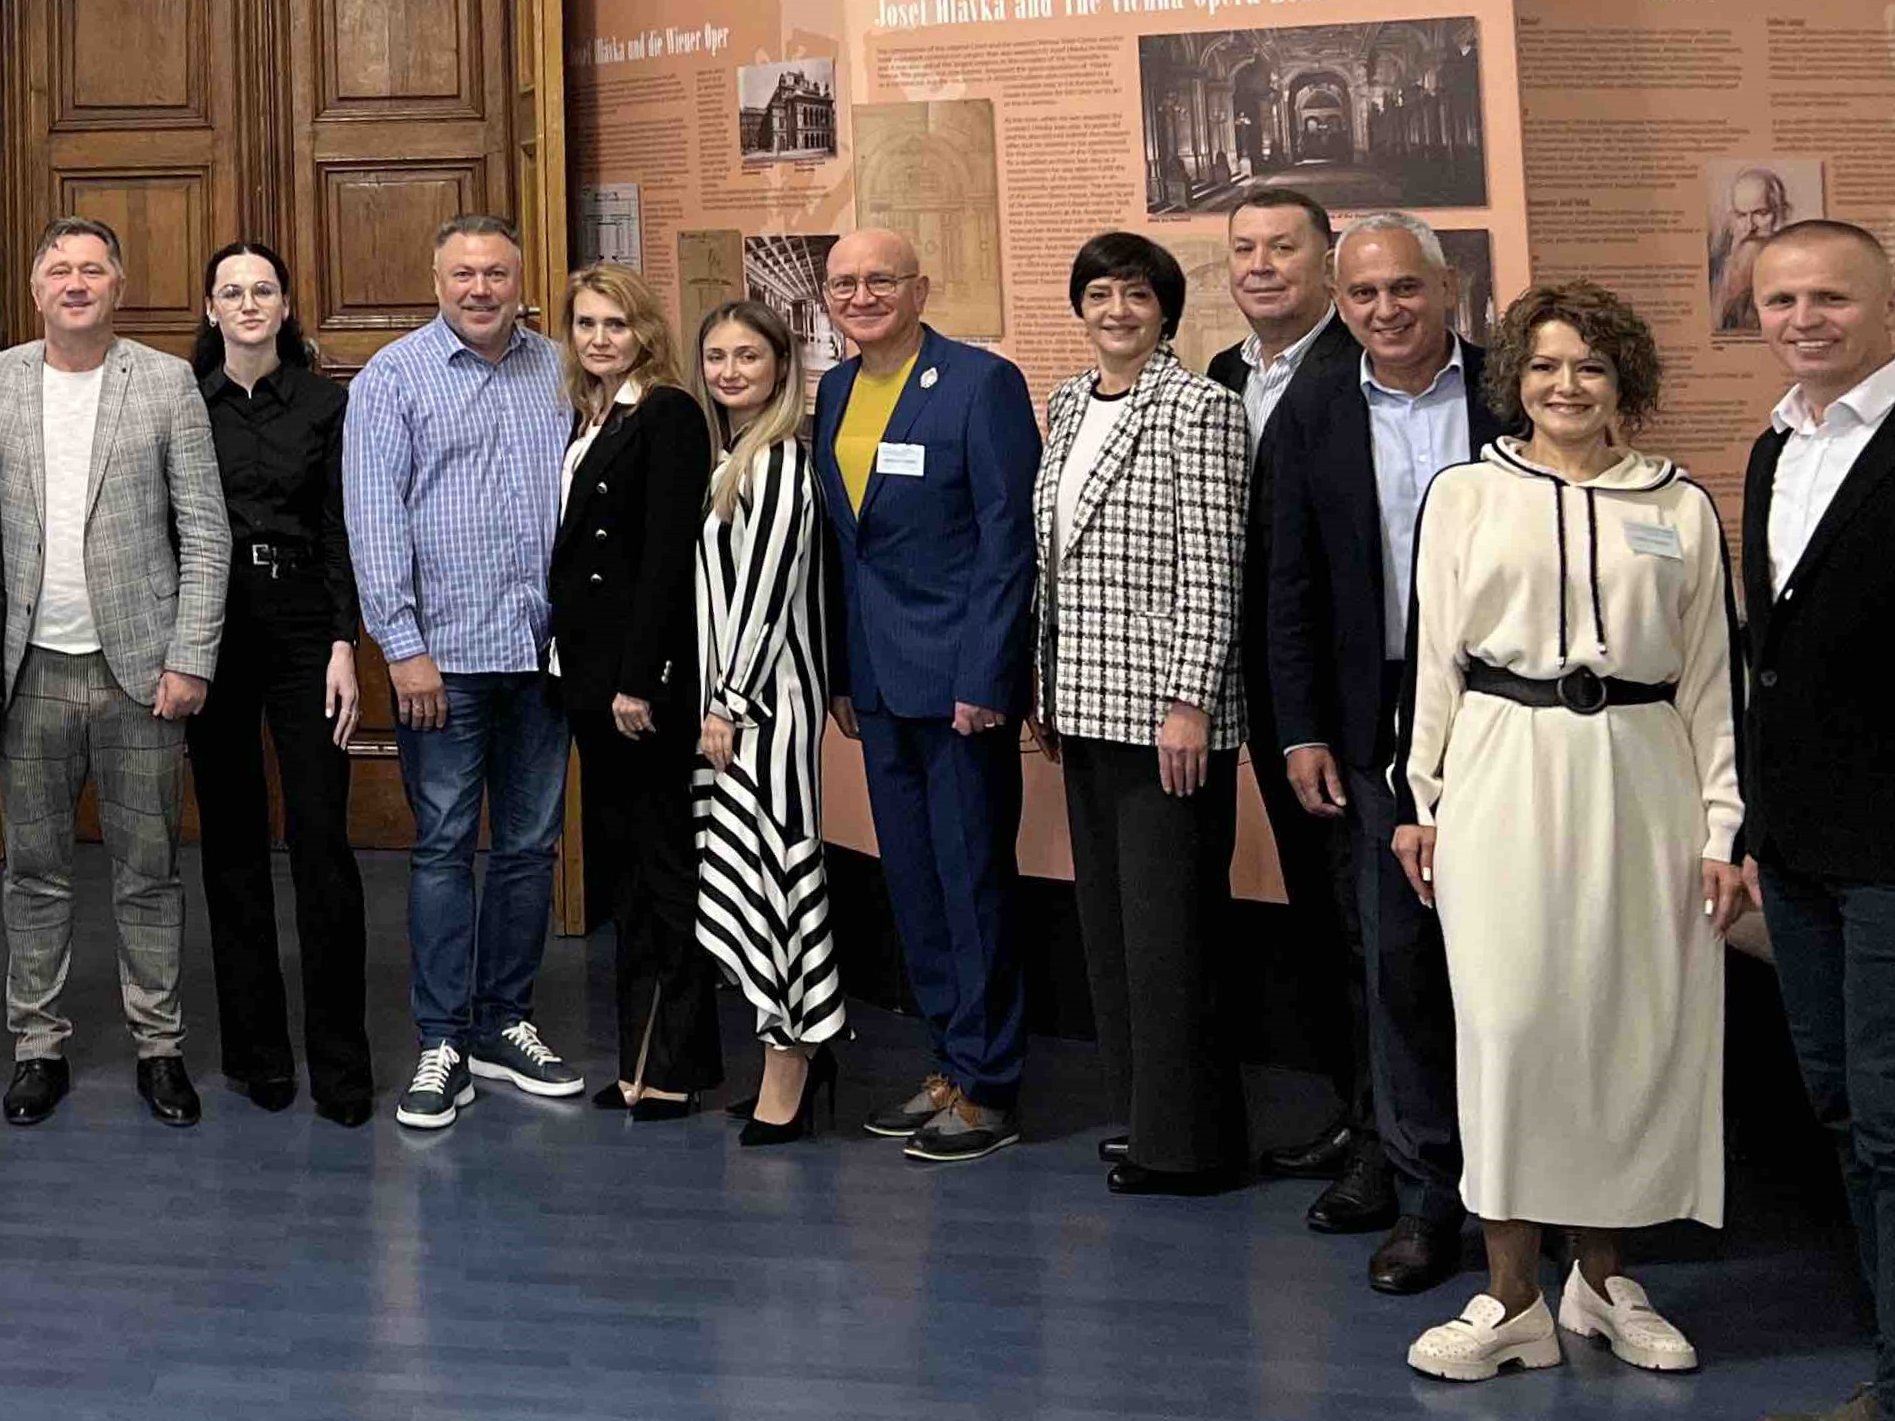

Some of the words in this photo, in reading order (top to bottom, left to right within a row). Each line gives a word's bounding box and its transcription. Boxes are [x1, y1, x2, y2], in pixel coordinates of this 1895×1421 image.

[628, 31, 646, 61] und
[648, 30, 663, 58] die
[666, 26, 701, 56] Wiener
[704, 21, 729, 58] Oper
